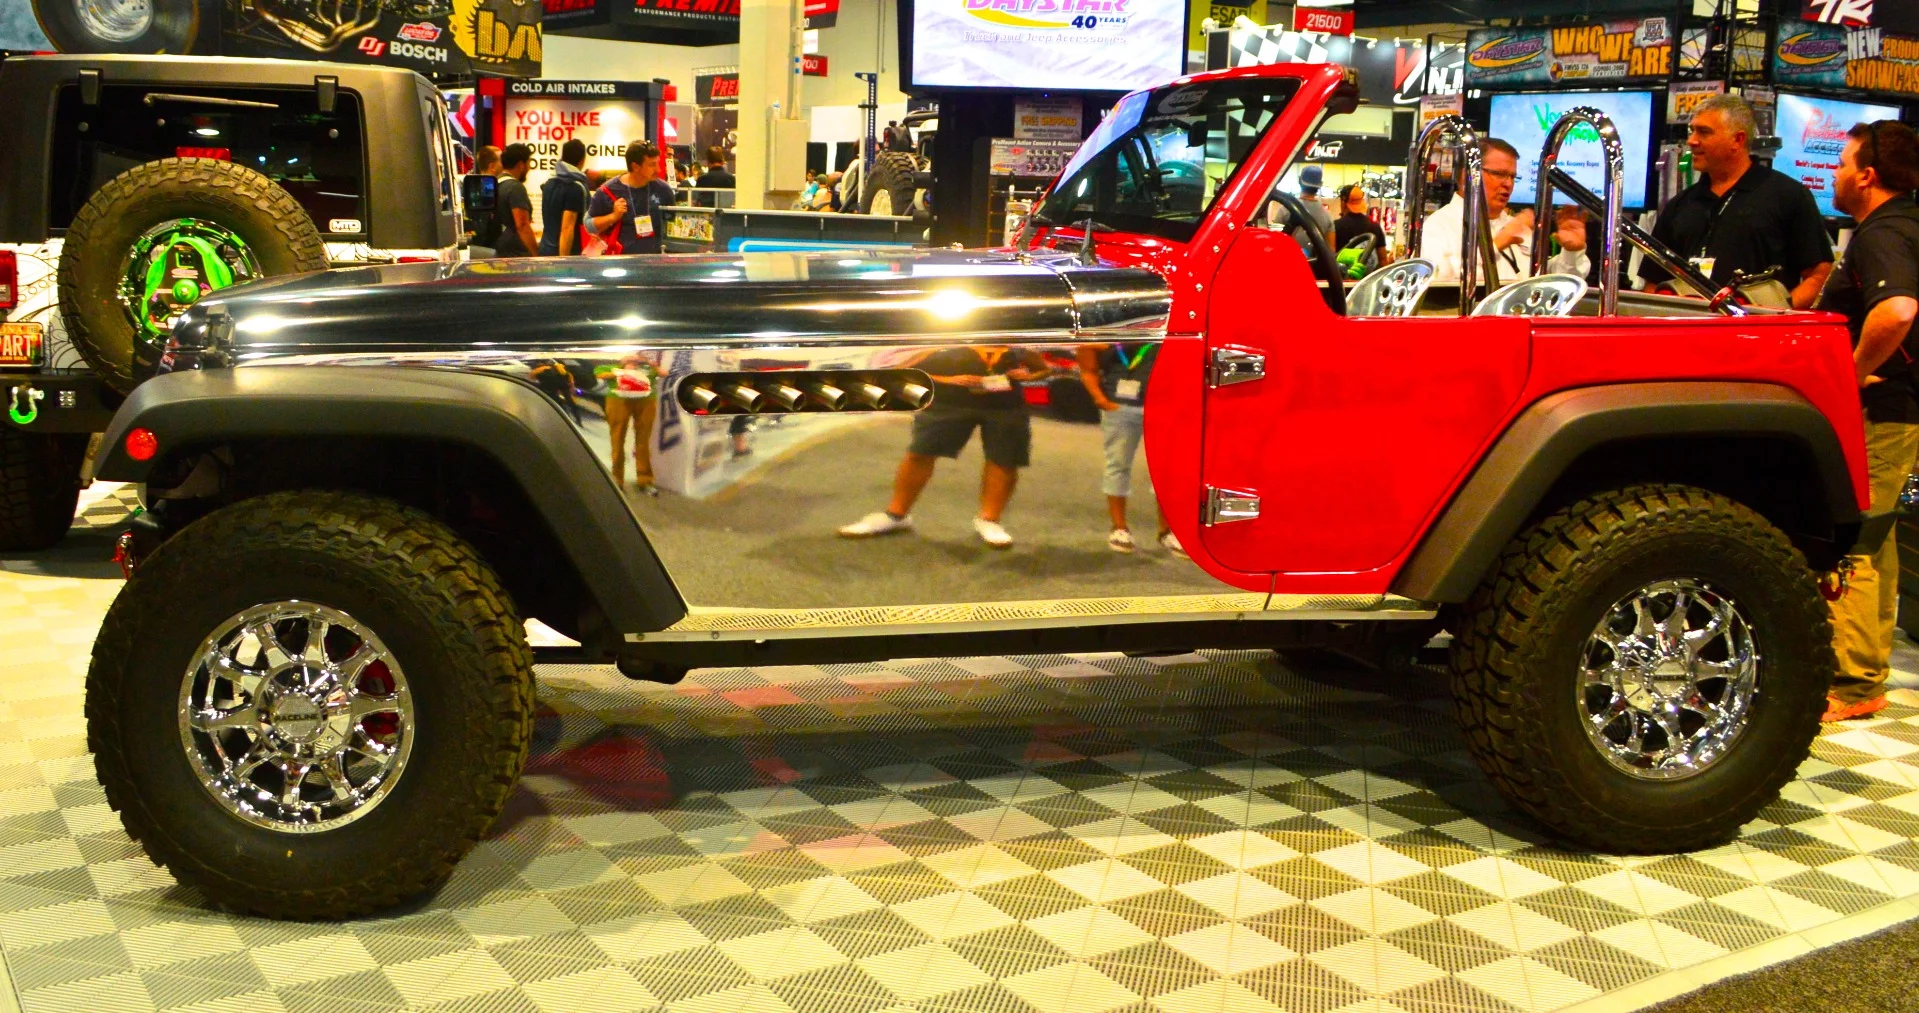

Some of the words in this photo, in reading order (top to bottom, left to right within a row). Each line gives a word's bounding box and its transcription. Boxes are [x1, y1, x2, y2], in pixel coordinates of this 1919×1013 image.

[1071, 15, 1097, 29] 40
[1306, 13, 1342, 30] 21500
[1553, 26, 1604, 57] WHO
[1599, 32, 1634, 63] WE
[1629, 45, 1672, 76] ARE
[1847, 27, 1883, 61] NEW
[390, 41, 448, 63] BOSCH
[512, 83, 542, 93] COLD
[546, 84, 565, 93] AIR
[568, 84, 616, 94] INTAKES
[515, 111, 553, 125] YOU
[560, 112, 600, 126] LIKE
[516, 126, 532, 140] IT
[538, 126, 575, 140] HOT
[526, 143, 558, 156] OUR
[0, 335, 31, 357] ART
[274, 713, 319, 723] RACELINE
